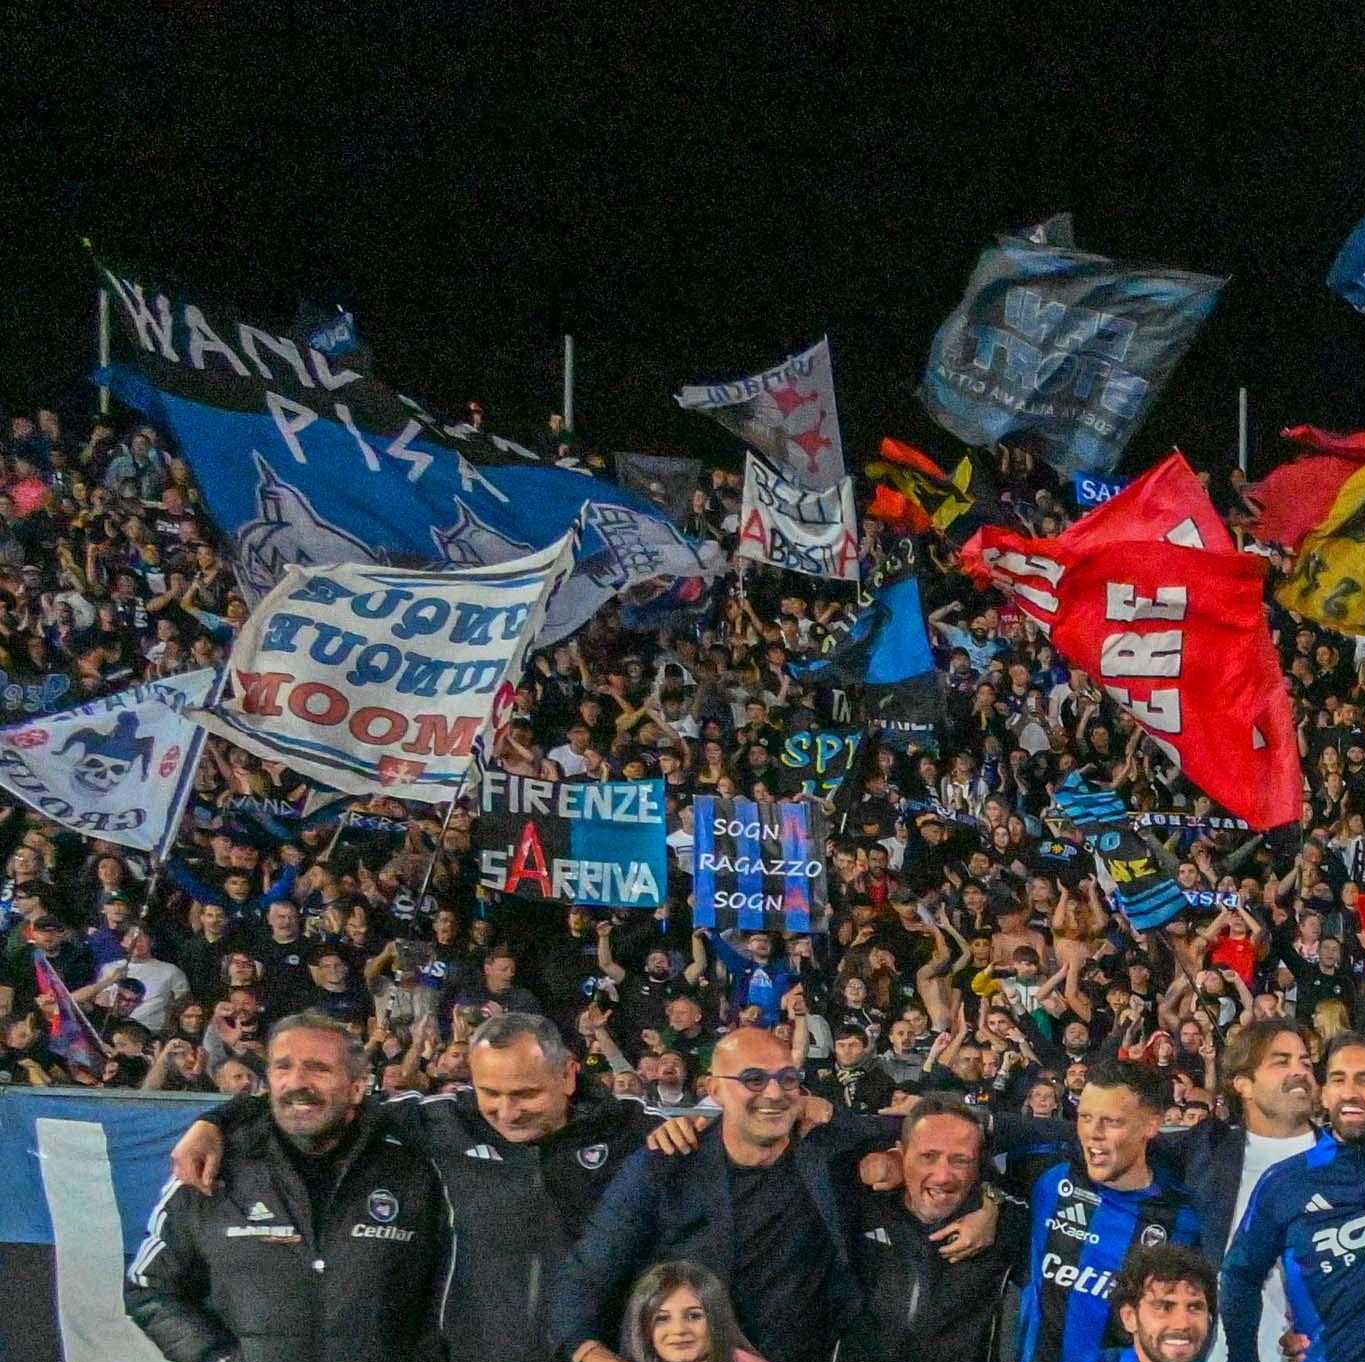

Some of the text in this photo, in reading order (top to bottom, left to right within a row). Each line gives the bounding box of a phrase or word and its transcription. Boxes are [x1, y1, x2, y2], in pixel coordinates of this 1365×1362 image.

[481, 773, 662, 823] FIRENZE
[480, 819, 660, 904] S'ARRIVA
[699, 851, 824, 878] RAGAZZO
[713, 889, 810, 912] SOGNA
[351, 1223, 417, 1243] Cetilar
[1041, 1252, 1117, 1300] Ceti
